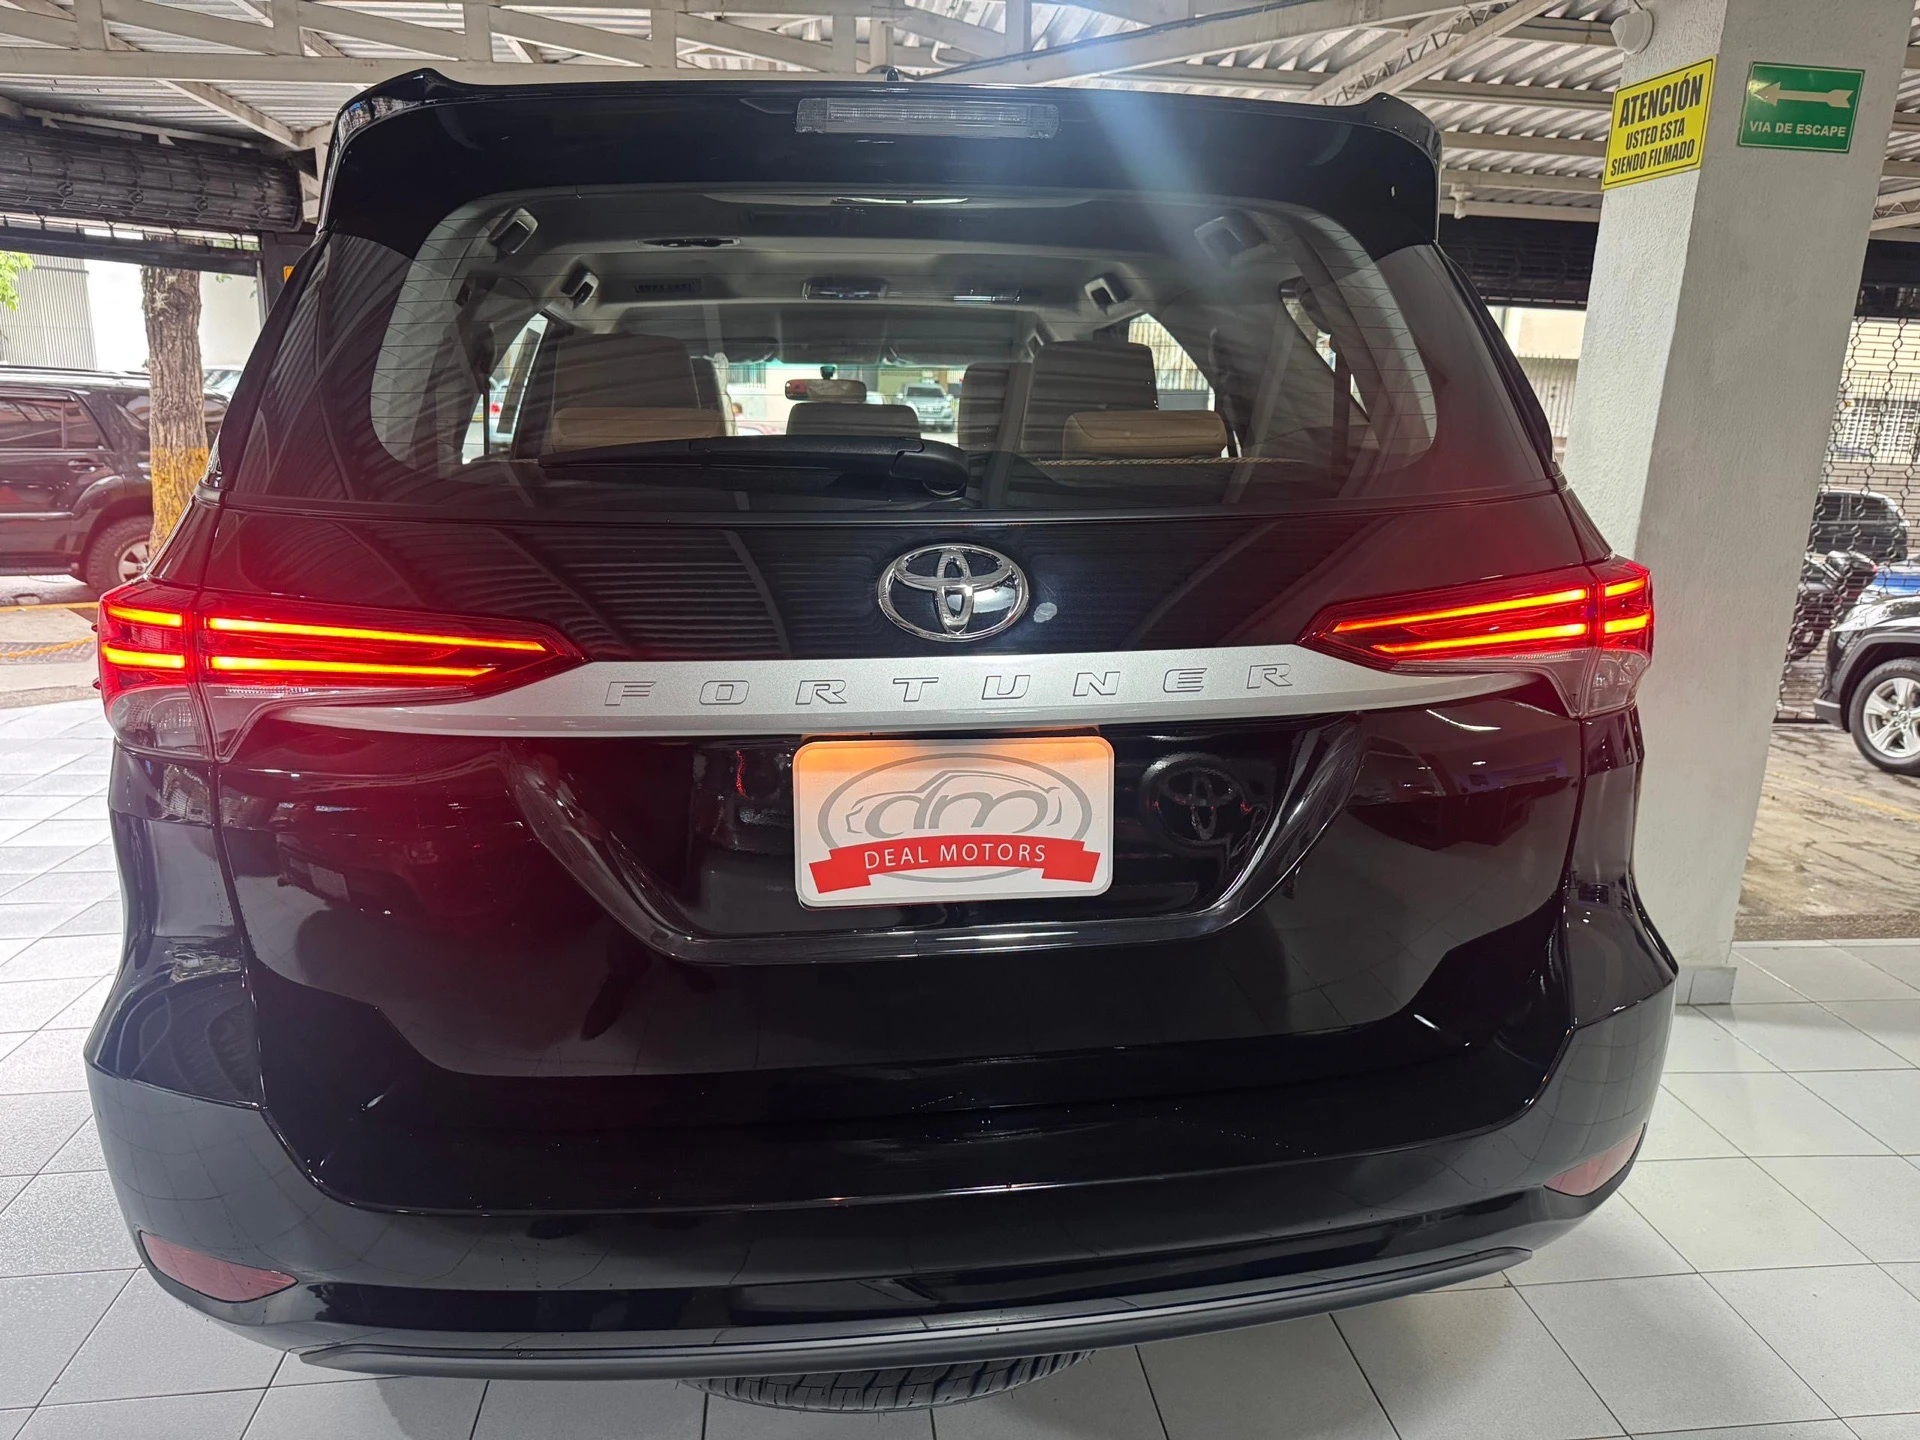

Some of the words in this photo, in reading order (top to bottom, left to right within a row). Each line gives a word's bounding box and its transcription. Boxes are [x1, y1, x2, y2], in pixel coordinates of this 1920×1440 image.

[1618, 73, 1704, 128] ATENCIÓN
[1625, 129, 1657, 150] USTED
[1659, 117, 1685, 140] ESTA
[1749, 120, 1772, 134] VIA
[1775, 122, 1792, 135] DE
[1796, 123, 1847, 138] ESCAPE
[1610, 149, 1647, 177] SIENDO
[1648, 139, 1695, 169] FILMADO
[604, 662, 1292, 707] FORTUNER
[864, 846, 929, 869] DEAL
[939, 843, 1047, 863] MOTORS
